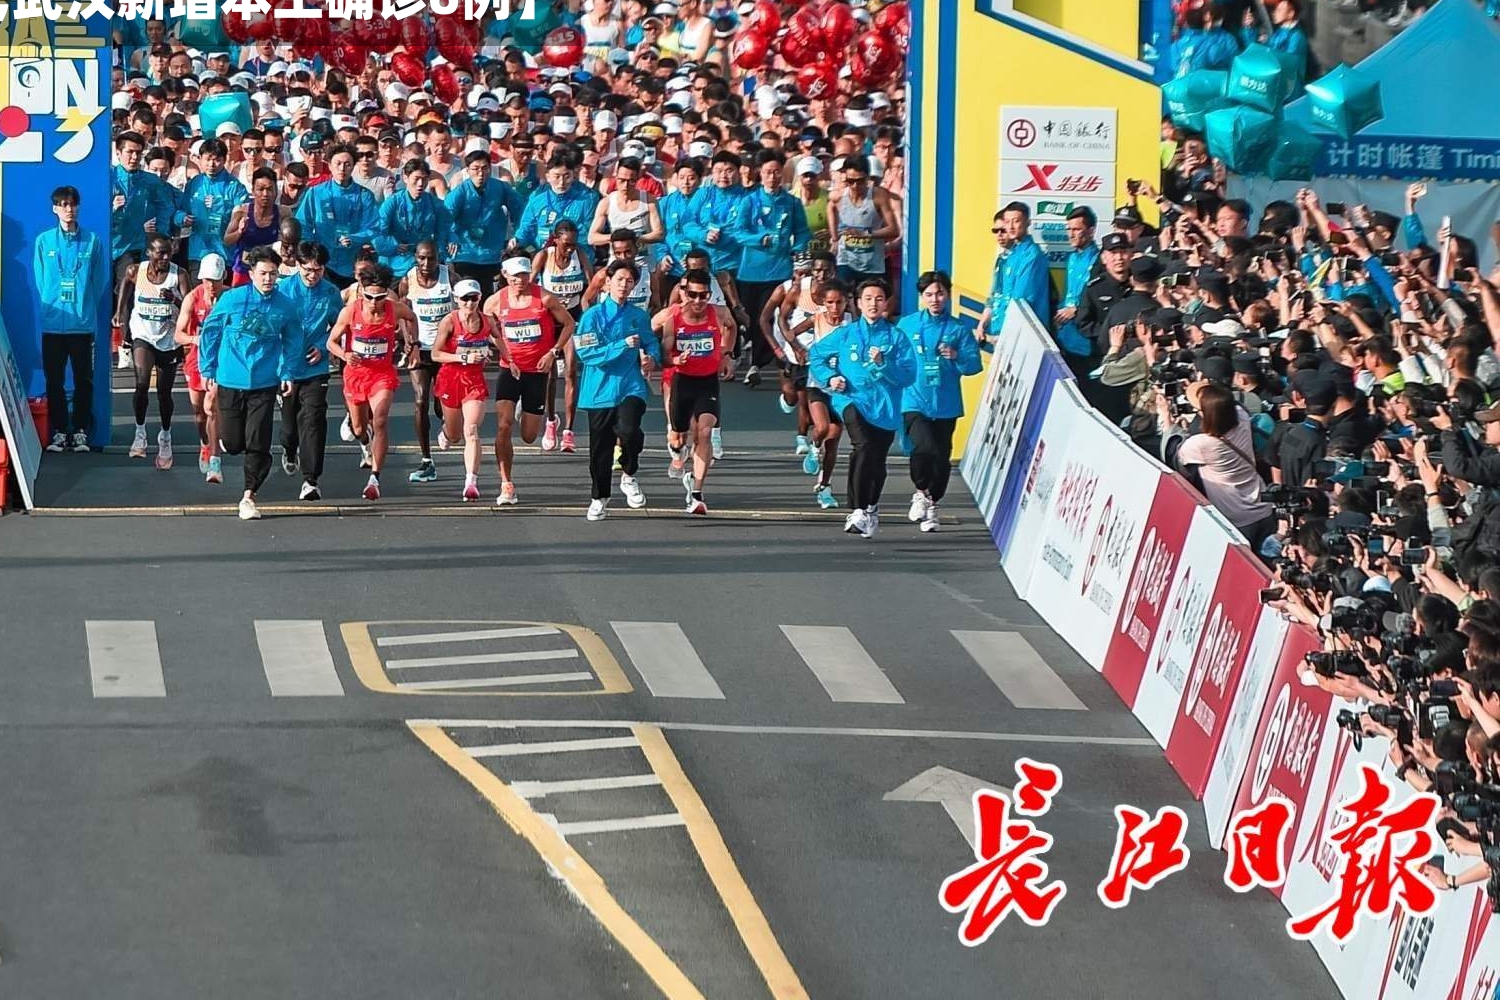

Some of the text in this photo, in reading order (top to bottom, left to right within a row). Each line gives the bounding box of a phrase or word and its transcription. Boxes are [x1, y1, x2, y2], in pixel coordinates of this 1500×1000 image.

[1055, 175, 1104, 192] 特步
[514, 329, 532, 338] WU
[363, 346, 378, 355] HE
[678, 342, 714, 350] YANG
